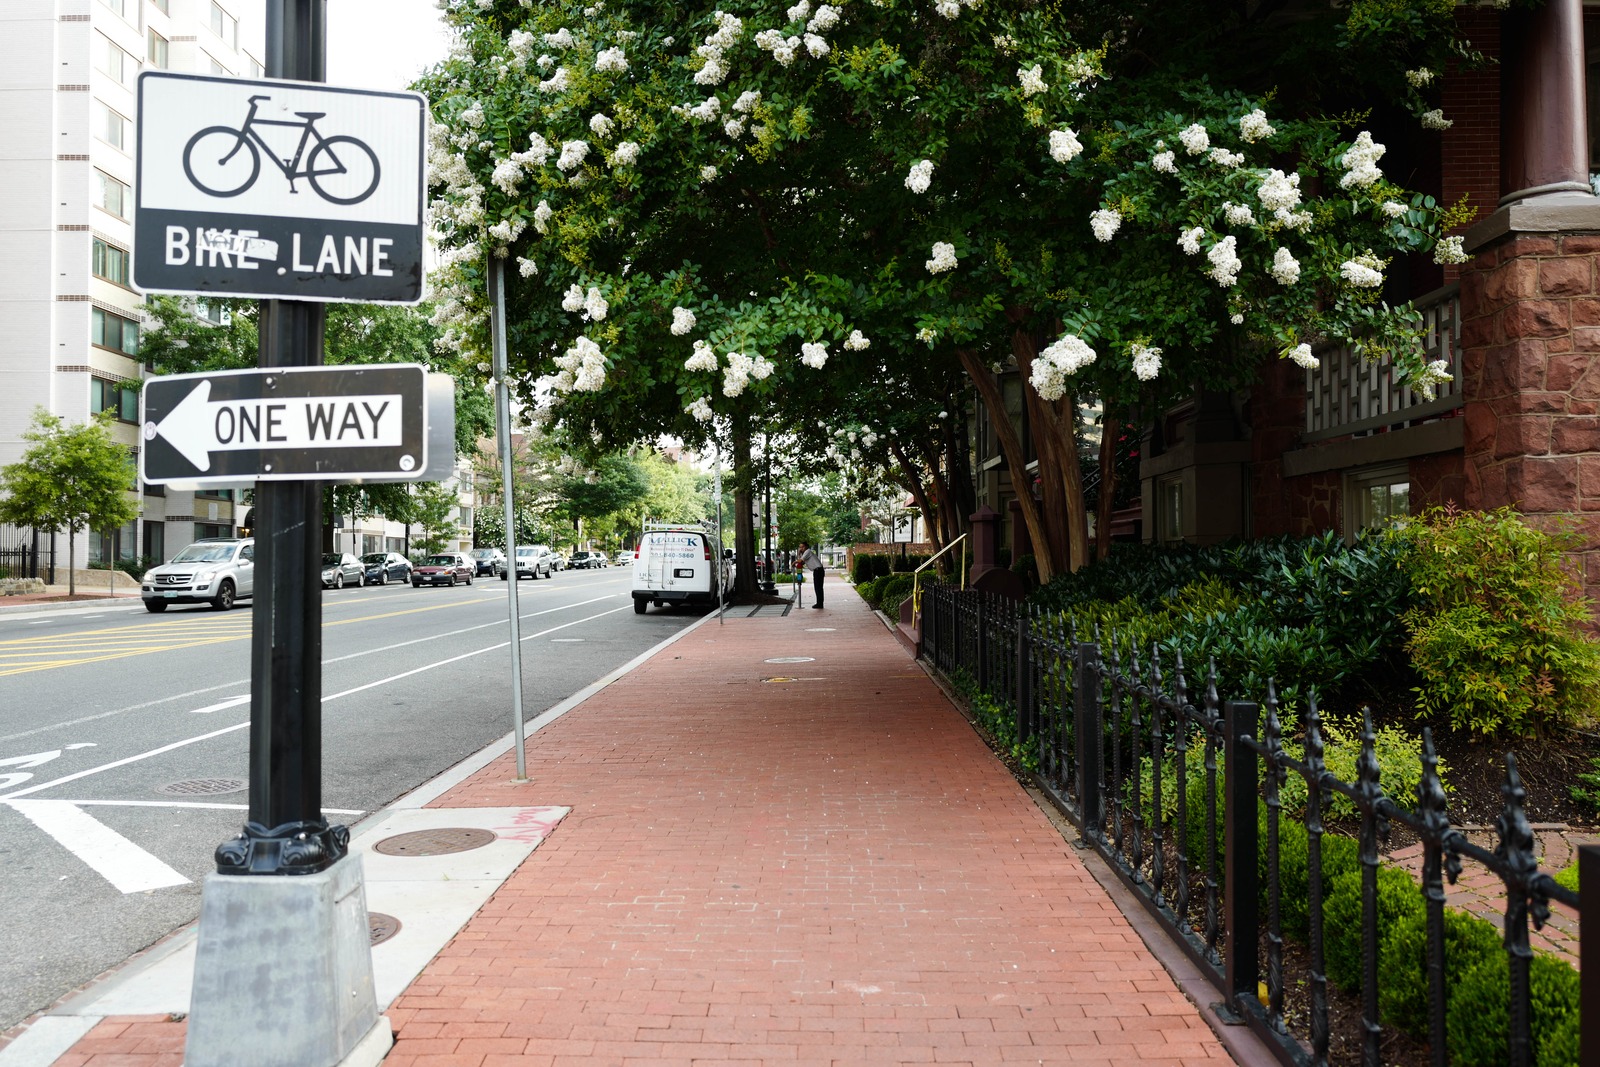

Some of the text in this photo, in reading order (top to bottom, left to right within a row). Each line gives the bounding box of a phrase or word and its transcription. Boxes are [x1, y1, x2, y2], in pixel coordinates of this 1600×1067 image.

[165, 225, 259, 269] BIKE
[292, 232, 394, 277] LANE
[214, 400, 390, 445] ONE WAY
